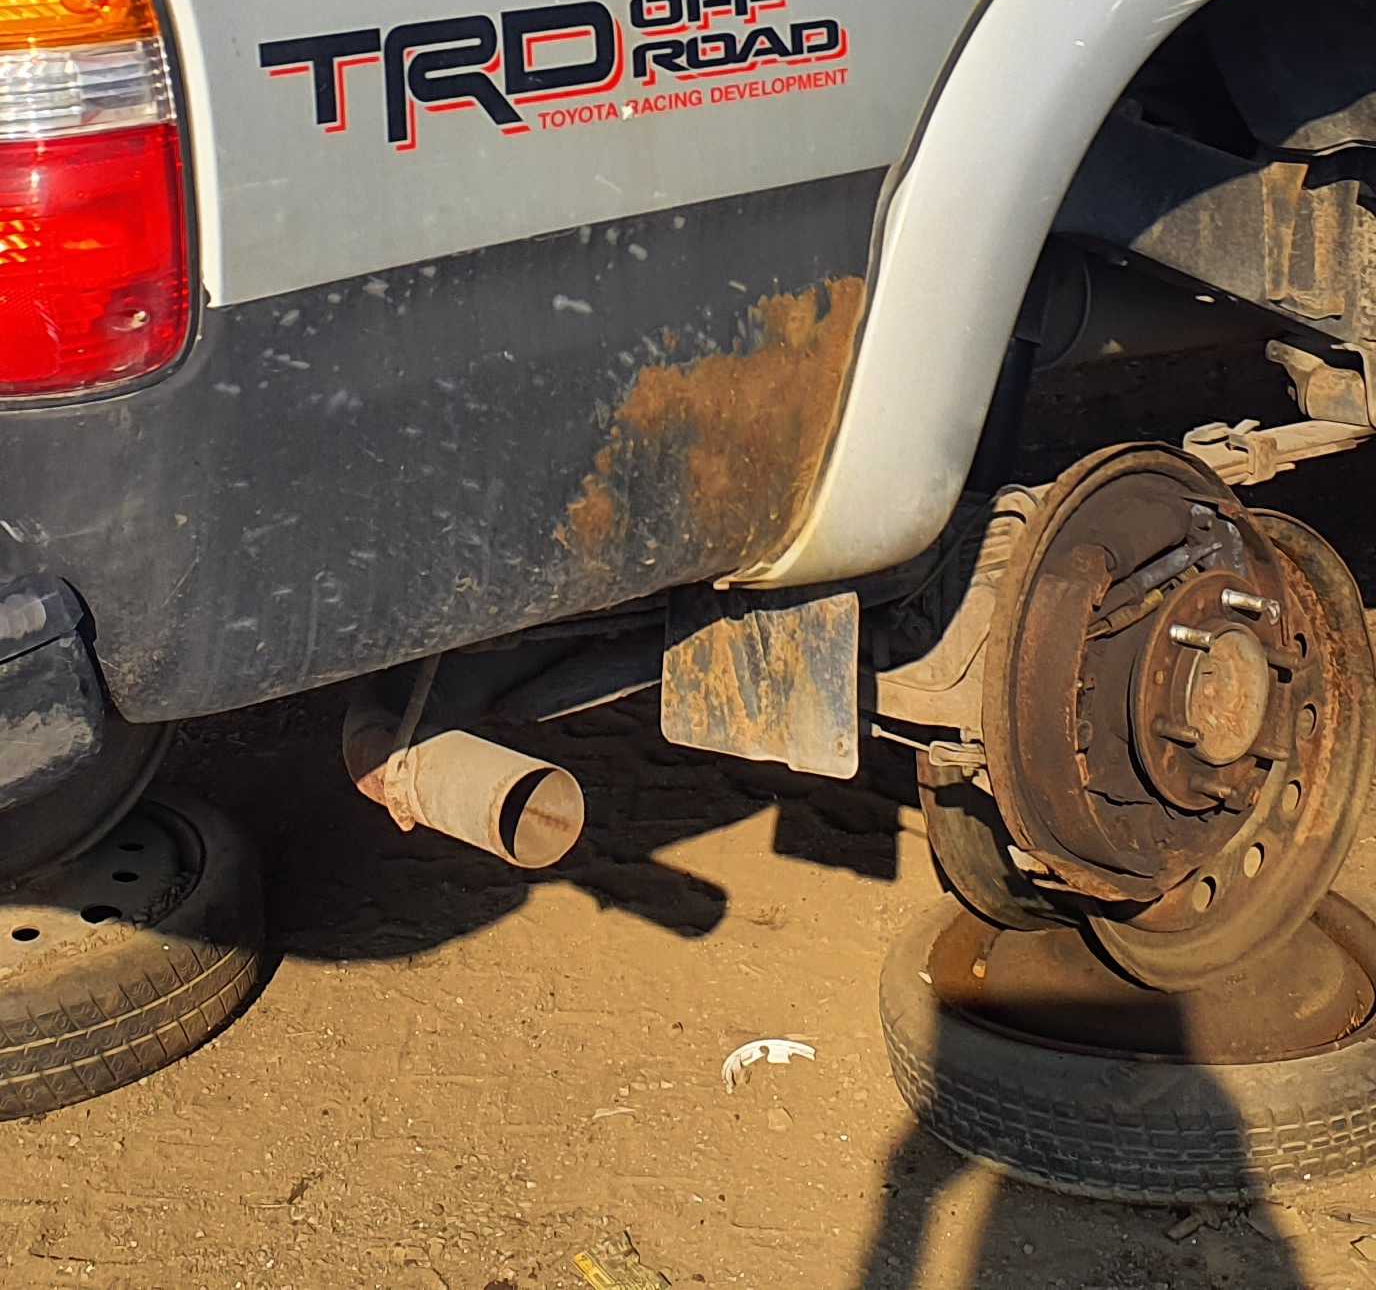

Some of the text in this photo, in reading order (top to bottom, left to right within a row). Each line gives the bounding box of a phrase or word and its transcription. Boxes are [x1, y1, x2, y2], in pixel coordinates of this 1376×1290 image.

[259, 0, 624, 151] TRD
[631, 18, 849, 86] ROAD
[537, 68, 849, 130] TOYOTA RACING DEVELOPMENT
